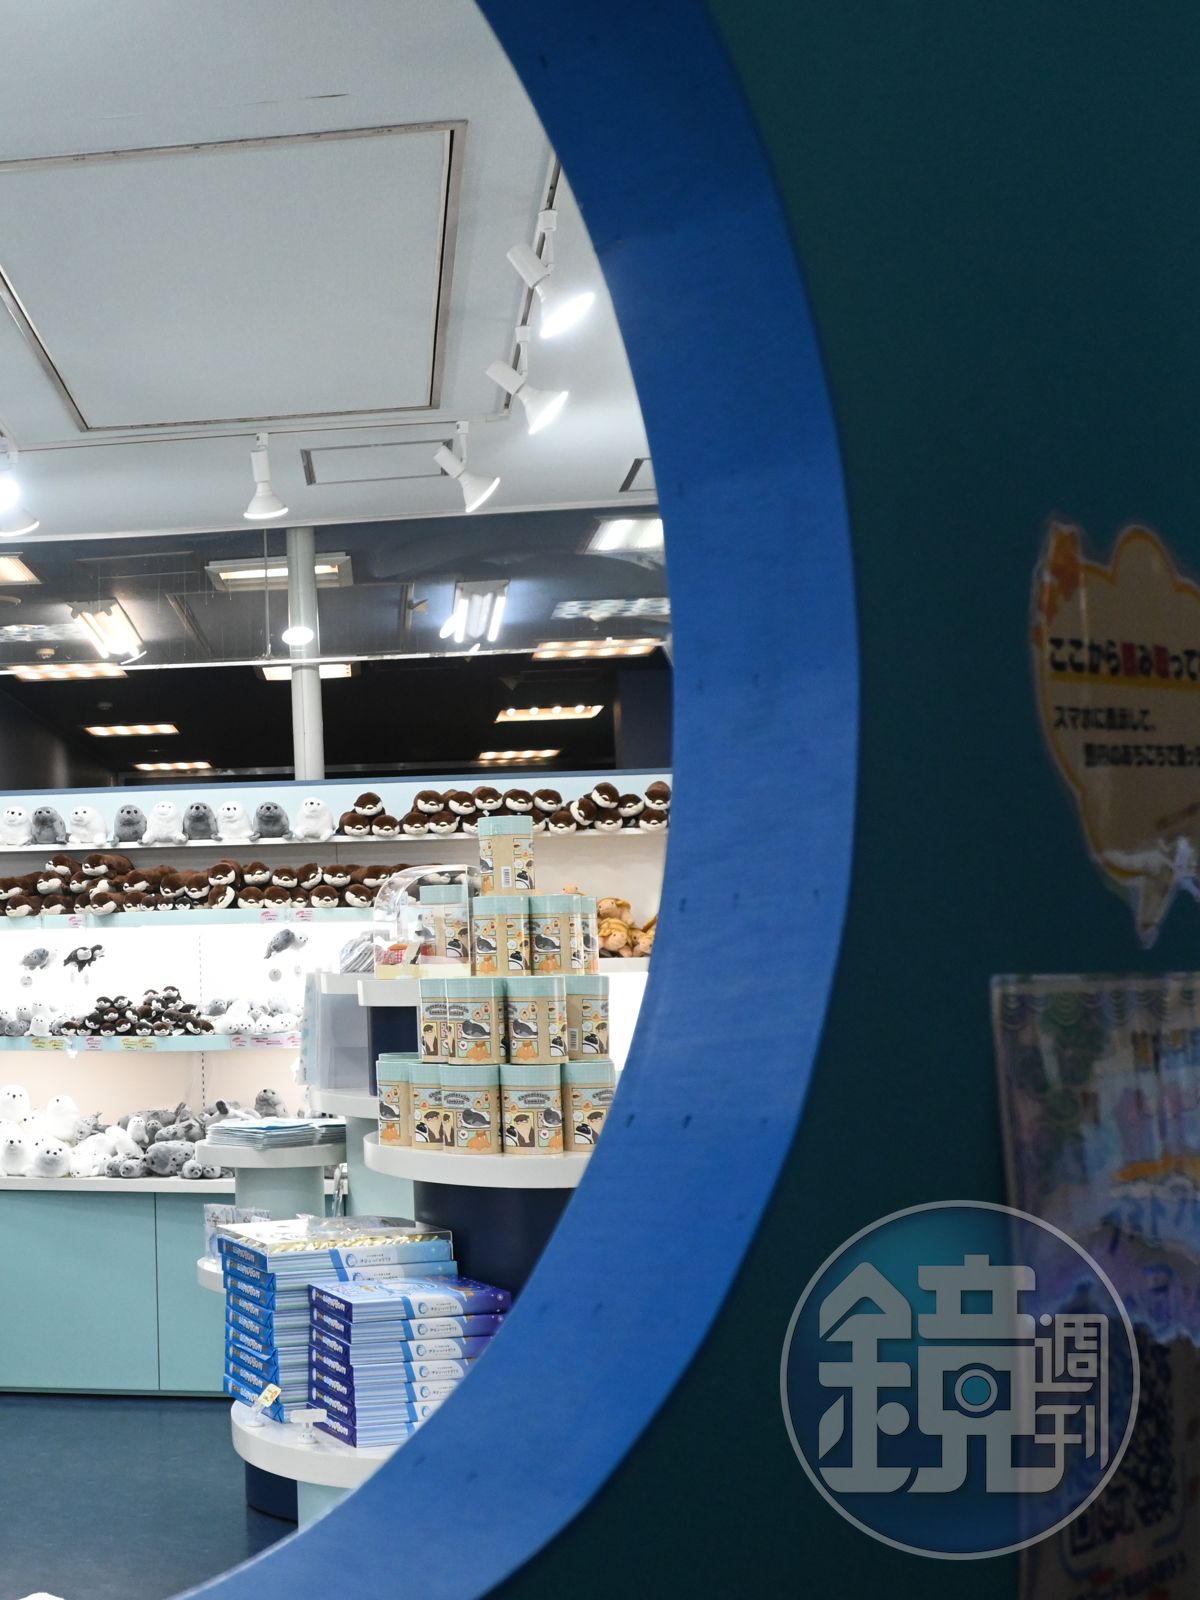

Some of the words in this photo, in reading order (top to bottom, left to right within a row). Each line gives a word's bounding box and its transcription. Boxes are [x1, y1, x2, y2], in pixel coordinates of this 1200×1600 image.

[1049, 637, 1200, 681] ここからみって
